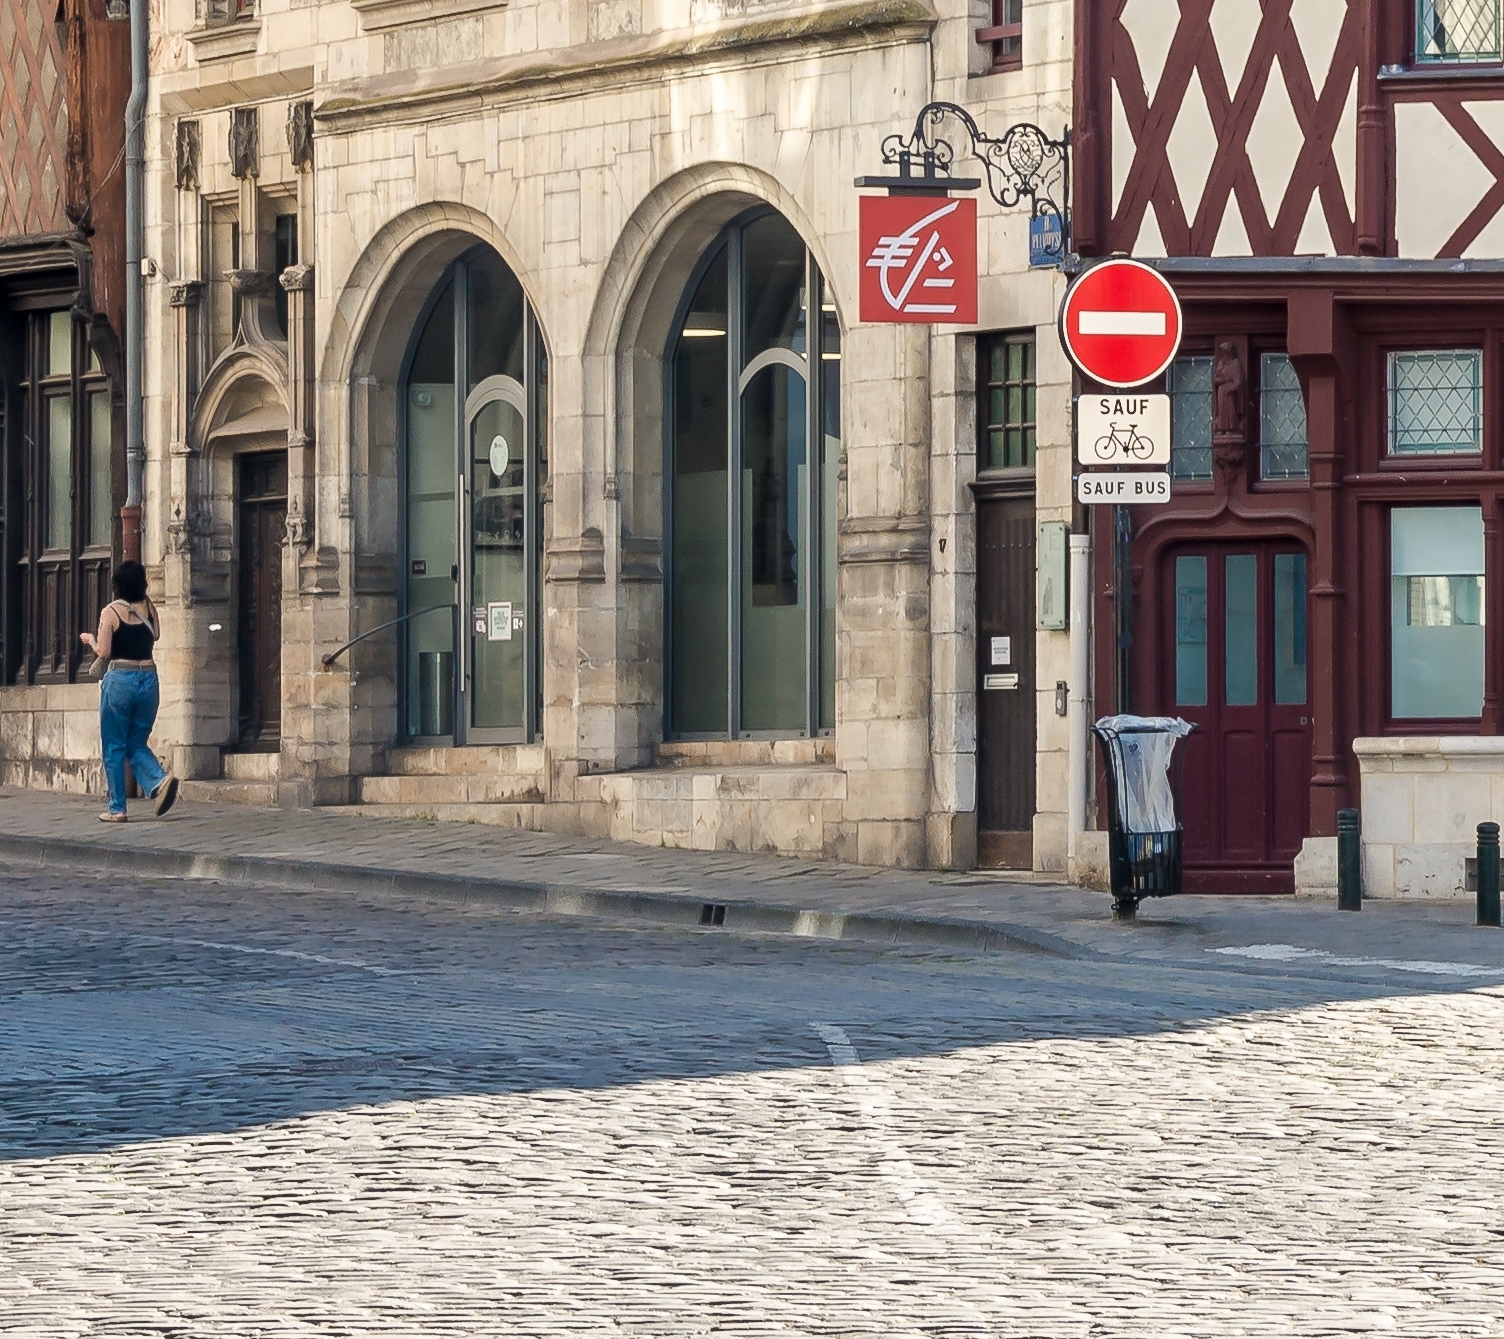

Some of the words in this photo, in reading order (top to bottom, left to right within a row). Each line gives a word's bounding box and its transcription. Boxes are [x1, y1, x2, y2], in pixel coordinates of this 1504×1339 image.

[1100, 398, 1149, 415] SAUF
[1083, 481, 1125, 495] SAUF
[1135, 481, 1166, 494] BUS
